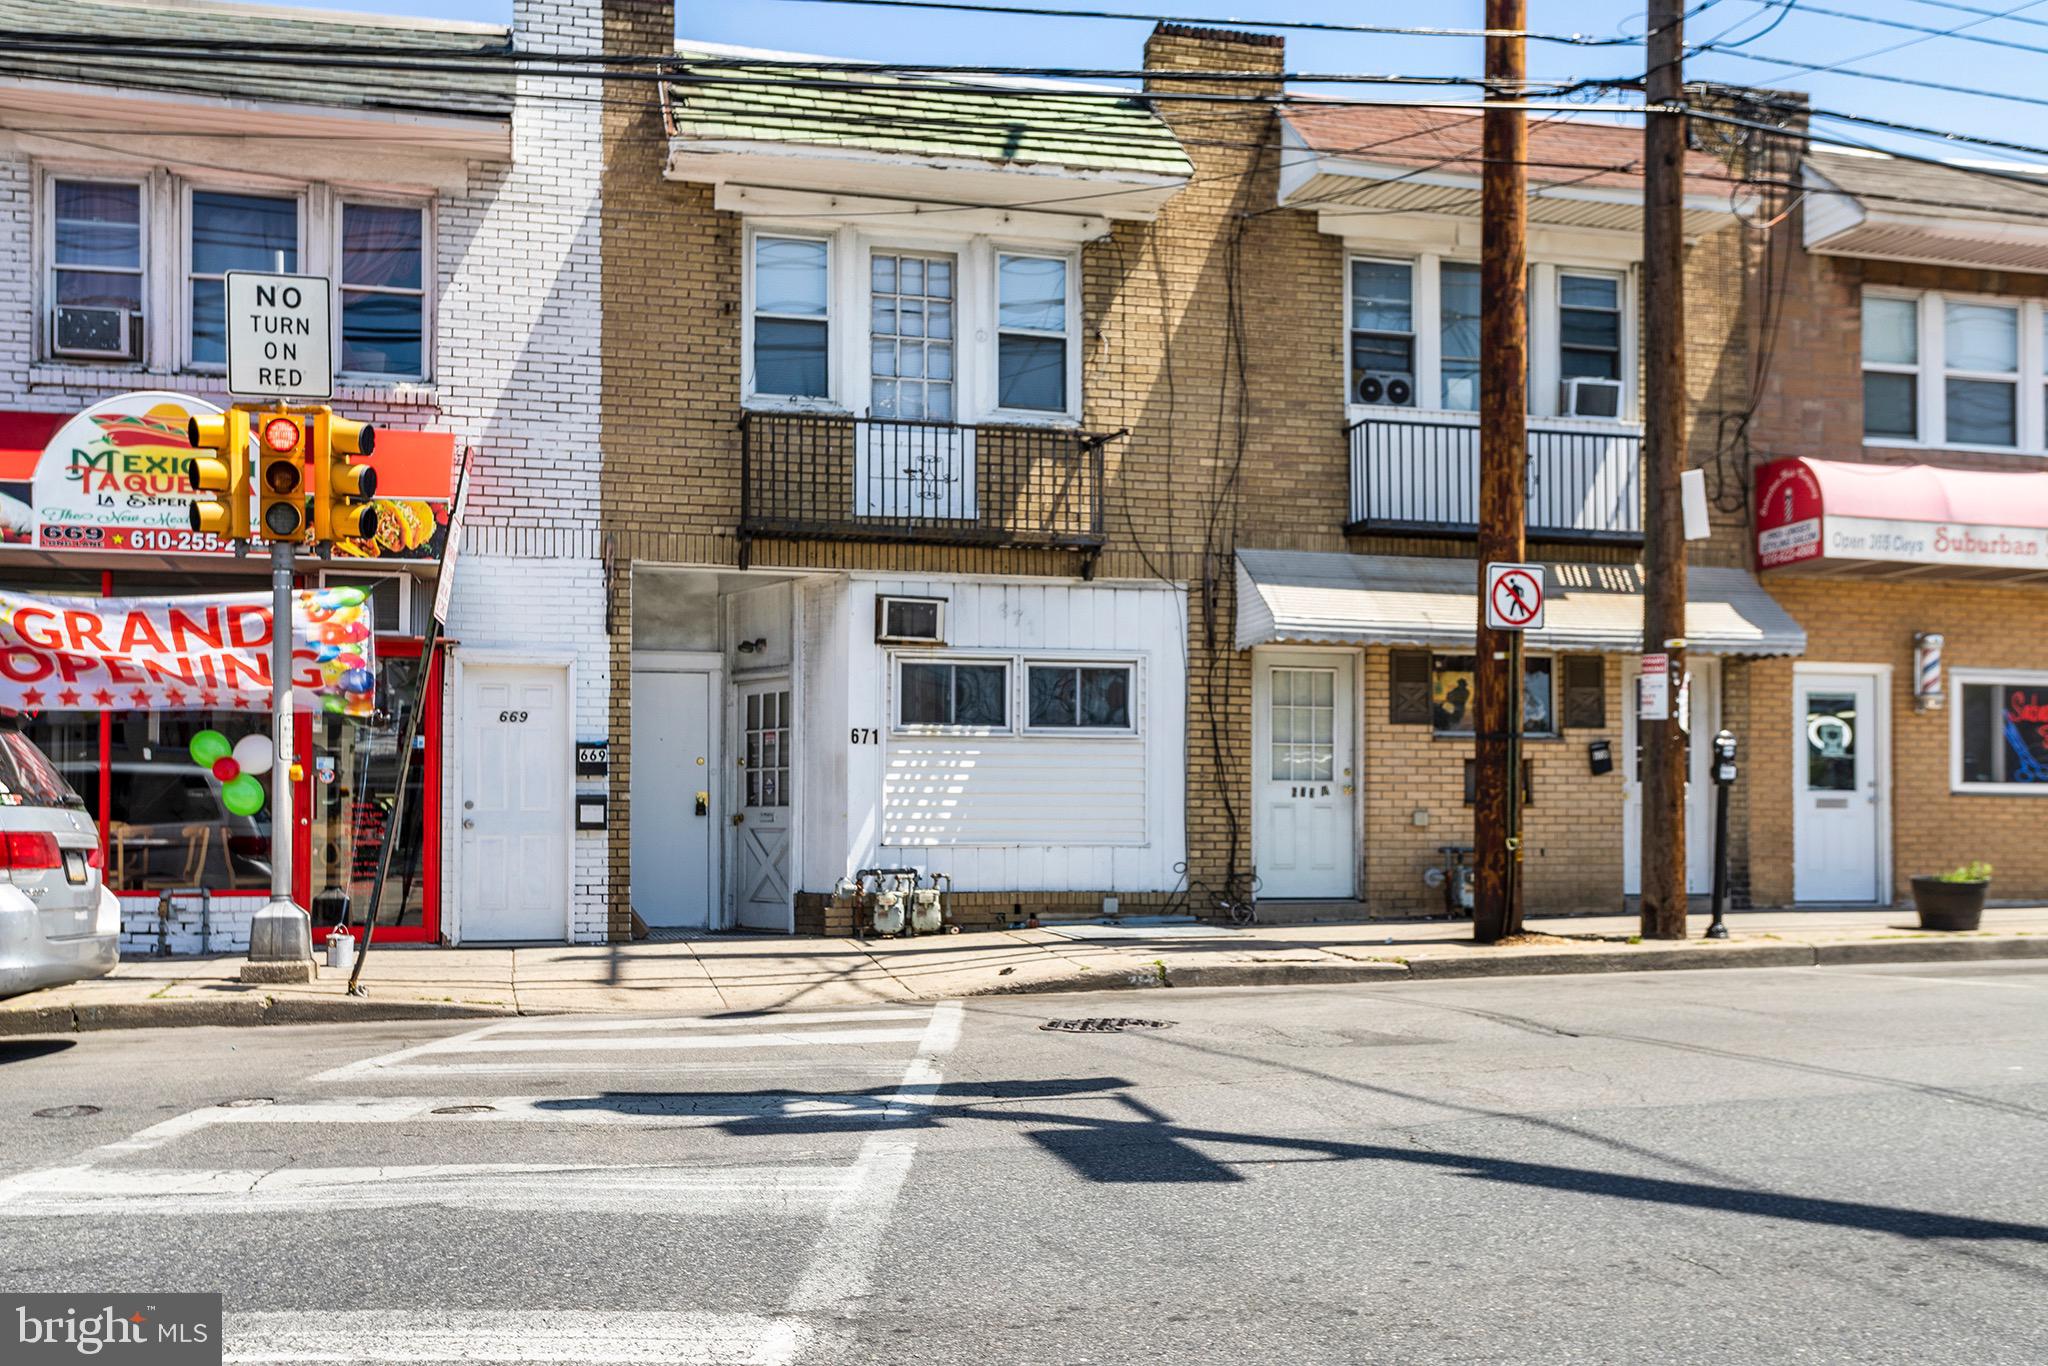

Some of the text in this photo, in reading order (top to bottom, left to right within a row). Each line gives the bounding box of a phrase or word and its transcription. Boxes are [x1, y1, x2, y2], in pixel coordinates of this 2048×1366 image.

[256, 284, 302, 309] NO
[250, 314, 310, 335] TURN
[264, 341, 297, 361] ON
[259, 367, 303, 387] RED
[97, 493, 115, 508] LA
[41, 506, 94, 521] The
[97, 510, 140, 524] New
[42, 524, 105, 540] 669
[1833, 532, 1865, 551] Open
[1893, 536, 1924, 556] Days
[1934, 527, 2038, 556] Suburban
[13, 605, 274, 653] GRAND
[0, 644, 325, 690] OPENING
[499, 711, 528, 723] 669
[850, 728, 879, 745] 671
[580, 750, 606, 762] 669
